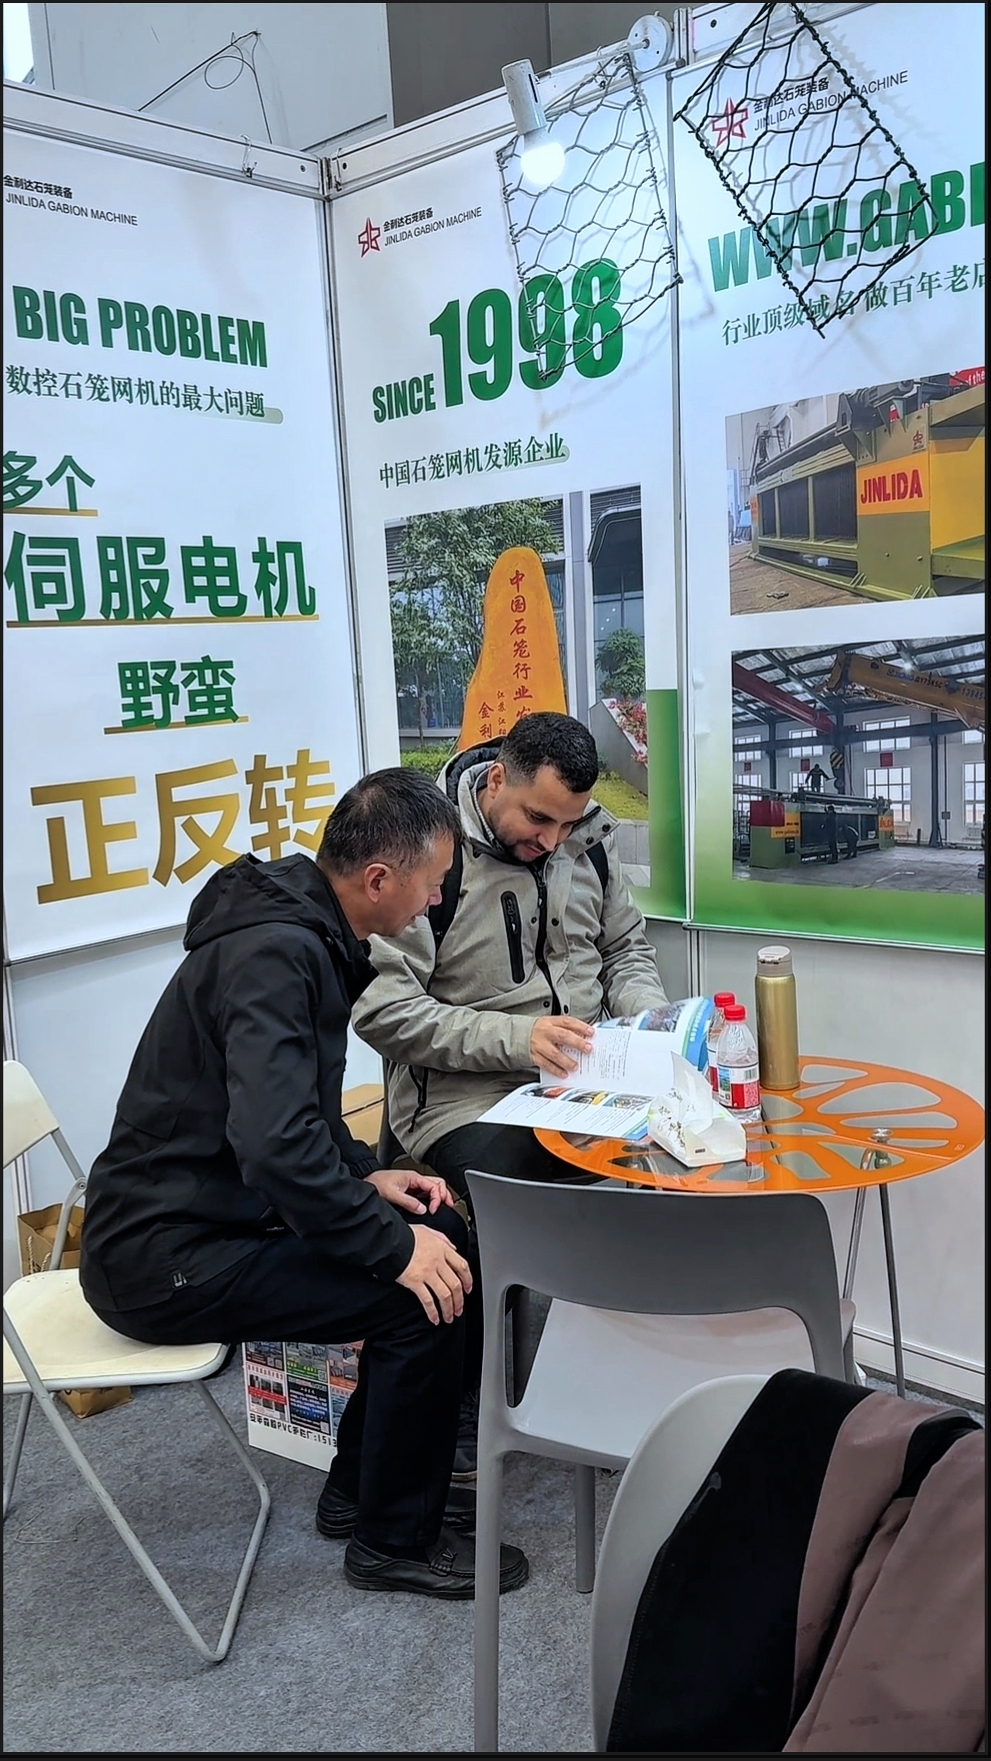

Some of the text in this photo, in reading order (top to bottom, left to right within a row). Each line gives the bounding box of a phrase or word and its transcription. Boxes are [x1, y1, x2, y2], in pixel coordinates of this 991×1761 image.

[754, 107, 796, 131] JINLIDA
[798, 89, 847, 116] GABION
[3, 175, 73, 199] 金利达石笼装备
[5, 192, 139, 226] JINLIDA GABION MACHINE
[383, 207, 434, 233] 金利达石笼装备
[384, 206, 483, 247] JINLIDA GABION MACHINE
[12, 285, 269, 369] BIG PROBLEM
[372, 257, 624, 424] SINCE 1998
[5, 364, 266, 419] 数控石笼网机的最大问题
[3, 450, 96, 513] 多个
[379, 432, 566, 490] 中国石笼网机发源企业
[860, 468, 923, 505] JINLIDA
[4, 531, 317, 623] 伺服电机
[117, 655, 240, 730] 野蛮
[30, 748, 337, 905] 正反转
